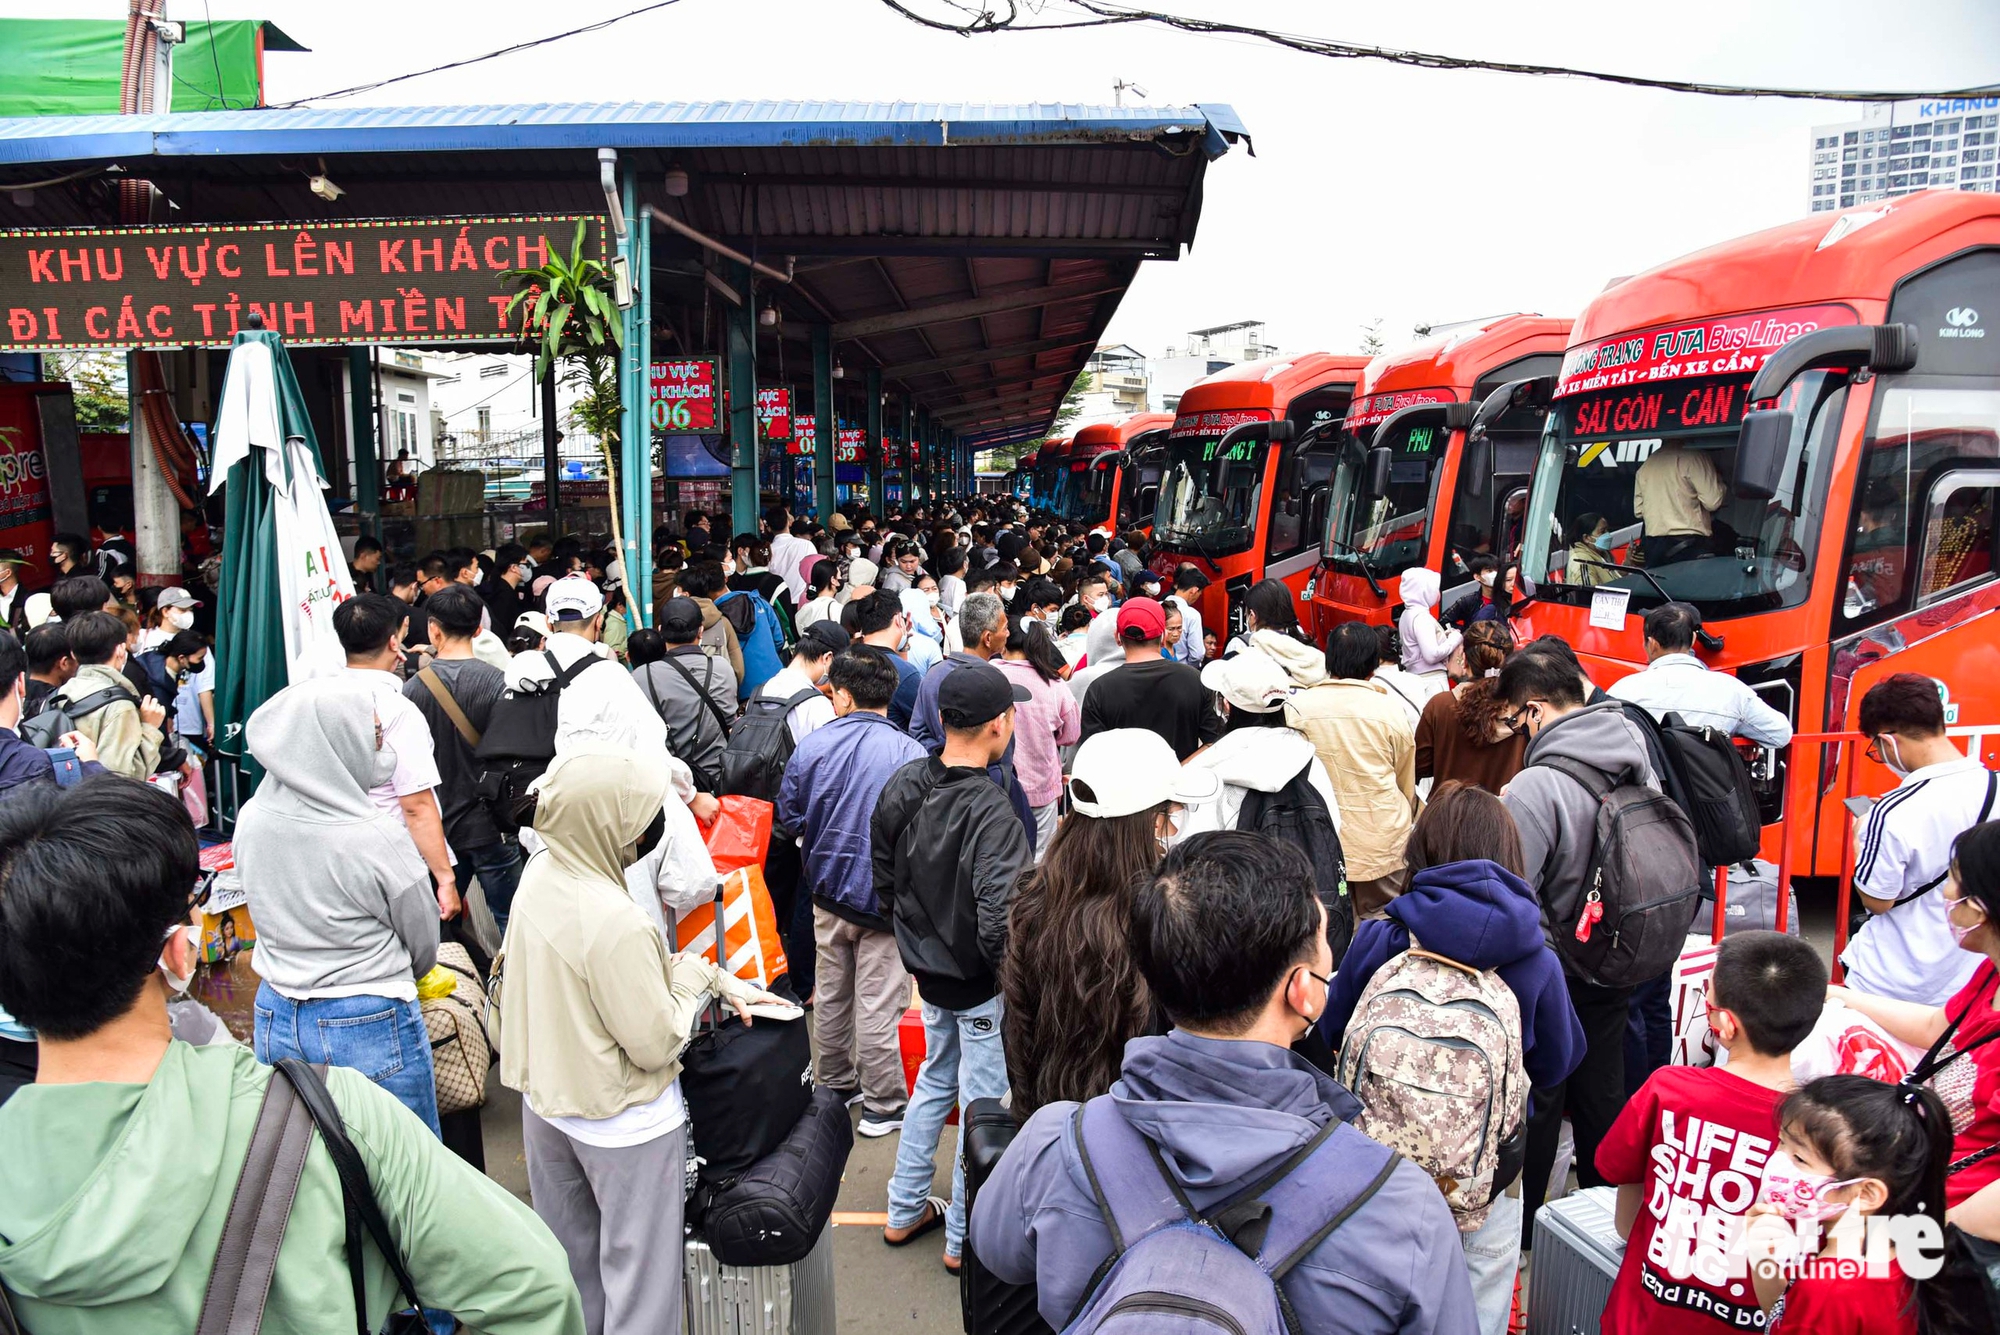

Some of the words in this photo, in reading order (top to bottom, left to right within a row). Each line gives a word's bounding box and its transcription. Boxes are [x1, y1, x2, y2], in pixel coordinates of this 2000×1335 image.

[28, 247, 123, 283] KHU
[146, 238, 242, 286] VỰC
[265, 231, 355, 276] LÊN
[380, 226, 548, 273] KHÁCH
[9, 307, 61, 341] ĐI
[85, 294, 174, 340] CÁC
[194, 292, 315, 336] TỈNH
[340, 287, 466, 334] MIỀN
[1939, 328, 1958, 338] KIM
[1959, 328, 1985, 338] LONG
[1597, 338, 1644, 369] TRANG
[1651, 327, 1705, 360] FUTA
[651, 365, 666, 379] HU
[669, 362, 699, 381] VỰC
[661, 382, 710, 399] KHÁCH
[1567, 380, 1581, 393] XE
[1581, 371, 1610, 390] MIỀN
[1610, 368, 1638, 385] TÂY
[1648, 358, 1682, 380] BẾN
[1683, 360, 1710, 376] XE
[1712, 350, 1757, 372] CẦN
[651, 399, 692, 429] 06
[1661, 1109, 1771, 1178] LIFE
[1650, 1143, 1755, 1213] SHO
[1686, 1288, 1729, 1319] the
